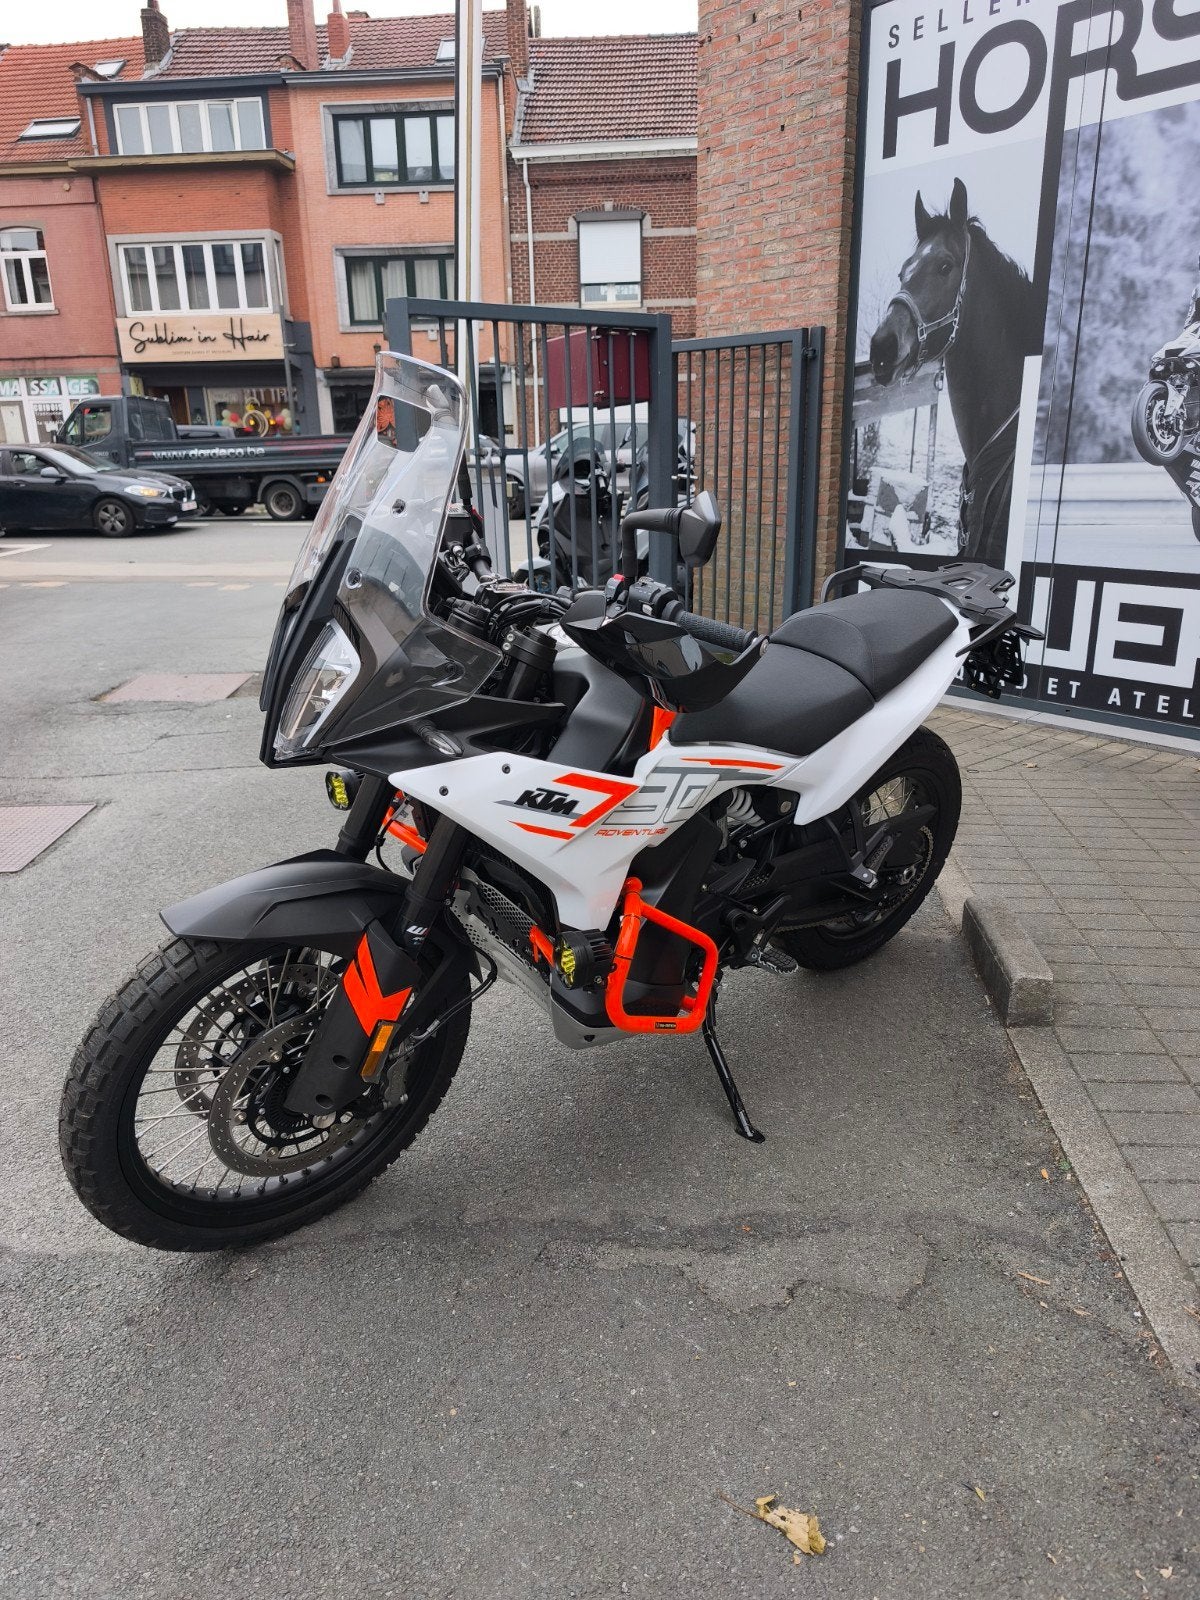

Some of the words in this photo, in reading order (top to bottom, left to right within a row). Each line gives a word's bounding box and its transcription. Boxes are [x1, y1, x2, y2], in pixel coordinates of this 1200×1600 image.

[888, 0, 1031, 48] SELLE
[222, 317, 270, 351] Hair
[1047, 677, 1081, 699] ET
[1108, 687, 1195, 718] ATEL
[513, 787, 581, 816] KTM
